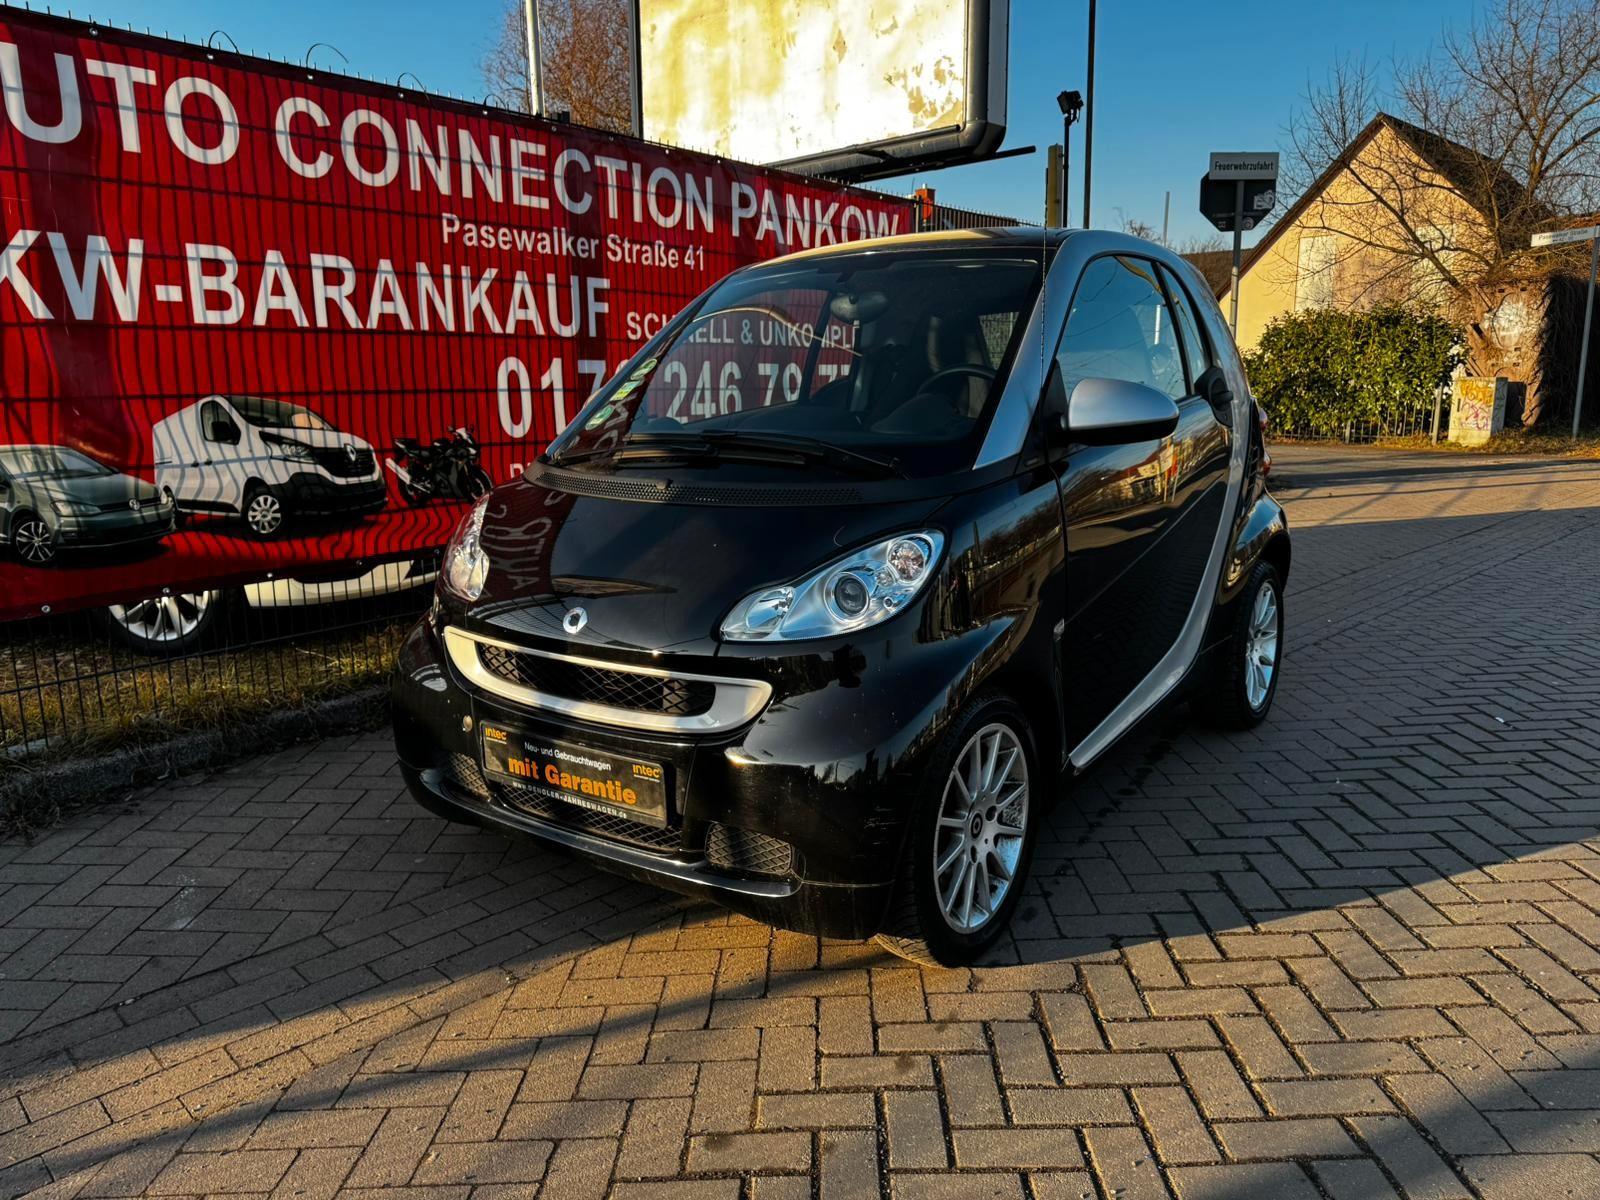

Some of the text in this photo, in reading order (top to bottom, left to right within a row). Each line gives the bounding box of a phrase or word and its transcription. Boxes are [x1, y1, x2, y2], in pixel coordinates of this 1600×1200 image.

[275, 97, 714, 233] CONNECTION
[731, 181, 899, 248] PANKOW
[1214, 160, 1274, 171] Feuerwehrzufahrt
[442, 212, 705, 271] Pasewalker Straße 41
[740, 318, 754, 345] &
[497, 356, 630, 438] 017
[663, 360, 742, 424] 246
[508, 756, 637, 805] mit Garantie
[541, 746, 554, 756] und
[554, 749, 612, 772] Gebrauchtwagen
